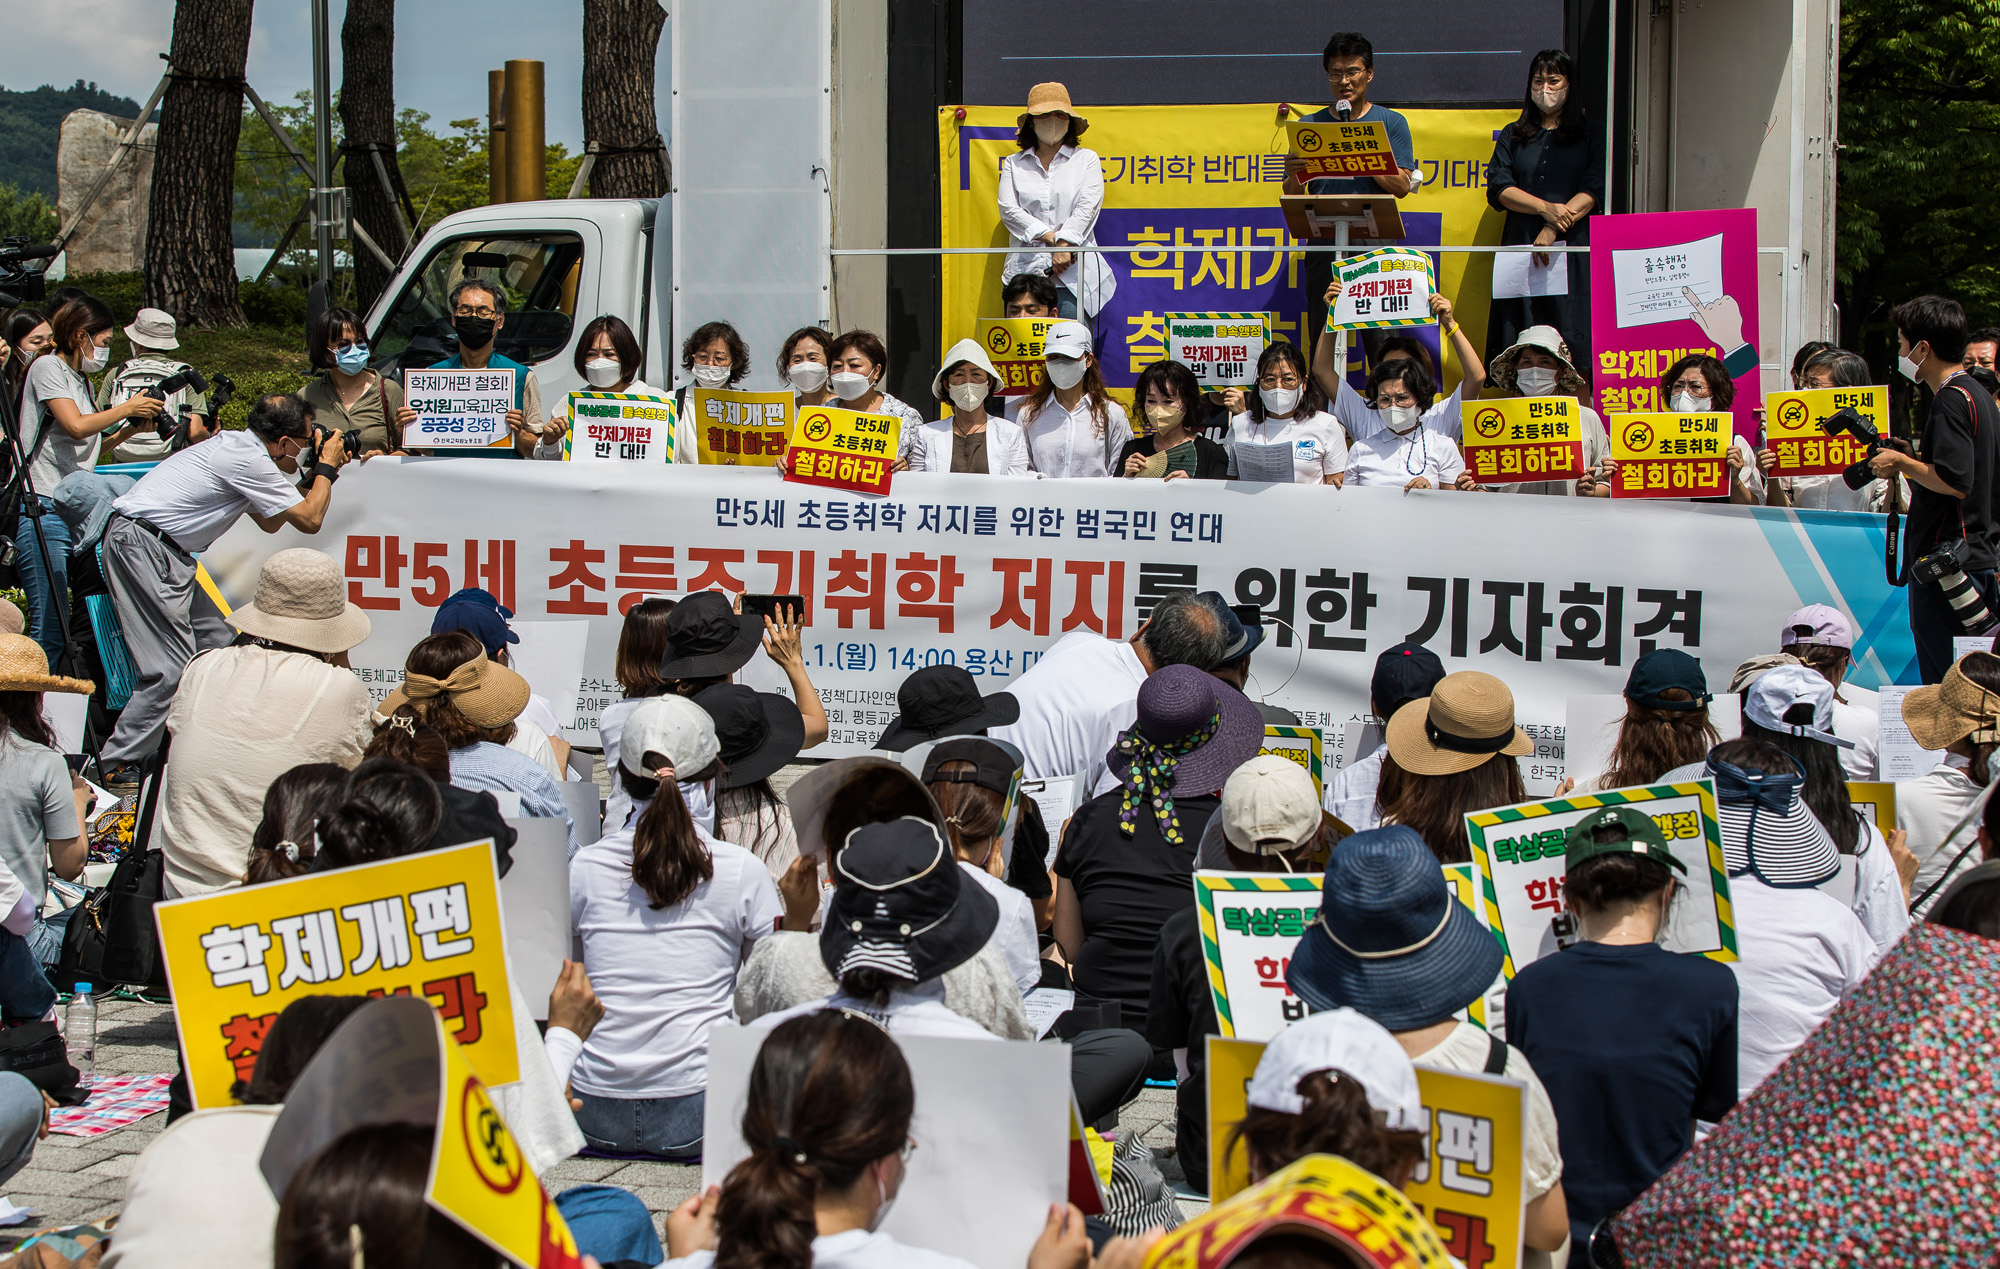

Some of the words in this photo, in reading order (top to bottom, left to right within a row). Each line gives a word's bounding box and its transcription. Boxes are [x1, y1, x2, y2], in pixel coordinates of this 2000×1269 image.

[1340, 125, 1375, 139] 만5세
[1328, 139, 1379, 153] 초등취학
[1203, 154, 1287, 184] 반대를
[1305, 155, 1388, 174] 철회하라
[1381, 259, 1426, 273] 졸속행정
[1645, 254, 1687, 274] 졸속행정
[1348, 278, 1413, 298] 학제개편
[1355, 298, 1372, 315] 반
[1381, 295, 1409, 312] 대!!
[1216, 325, 1262, 338] 졸속행정
[1016, 342, 1047, 357] 초등
[1182, 345, 1248, 362] 학제개편
[1191, 362, 1207, 378] 반
[1216, 362, 1244, 378] 대!!
[411, 376, 471, 391] 학제개편
[475, 375, 509, 391] 철회!
[409, 398, 509, 415] 유치원교육과정
[1529, 401, 1568, 419] 만5세
[1600, 385, 1673, 416] 철회
[1833, 392, 1874, 410] 만5세
[577, 404, 620, 418] 탁상공론
[622, 406, 667, 421] 졸속행정
[705, 397, 785, 427] 학제개편
[421, 417, 464, 433] 공공성
[467, 417, 496, 433] 강화
[588, 424, 651, 444] 학제개편
[855, 417, 890, 435] 만5세
[1511, 422, 1570, 440] 초등취학
[1679, 418, 1719, 433] 만5세
[707, 426, 787, 456] 철회하라
[832, 433, 887, 454] 초등취학
[1659, 437, 1719, 455] 초등취학
[595, 442, 612, 458] 반
[620, 443, 646, 460] 대!!
[794, 450, 885, 487] 철회하라
[1475, 446, 1575, 476] 철회하라
[1621, 462, 1722, 491] 철회하라
[716, 498, 785, 529] 만5세
[797, 500, 907, 533] 초등취학
[917, 504, 998, 536] 저지를
[1010, 506, 1065, 538] 위한
[1076, 508, 1156, 541] 범국민
[1170, 511, 1223, 544] 연대
[1888, 531, 1896, 556] Canon
[344, 535, 517, 615] 만5세
[989, 557, 1198, 640] 저지를
[1234, 567, 1378, 652] 위한
[1405, 576, 1703, 667] 기자회견
[801, 641, 877, 673] .1.(월)
[887, 647, 956, 671] 14:00
[964, 648, 1014, 677] 용산
[814, 688, 896, 707] 정책디자인연
[1515, 724, 1566, 741] 동조합
[1493, 826, 1575, 865] 탁상공
[1525, 876, 1567, 913] 학
[200, 882, 475, 997] 학제개편
